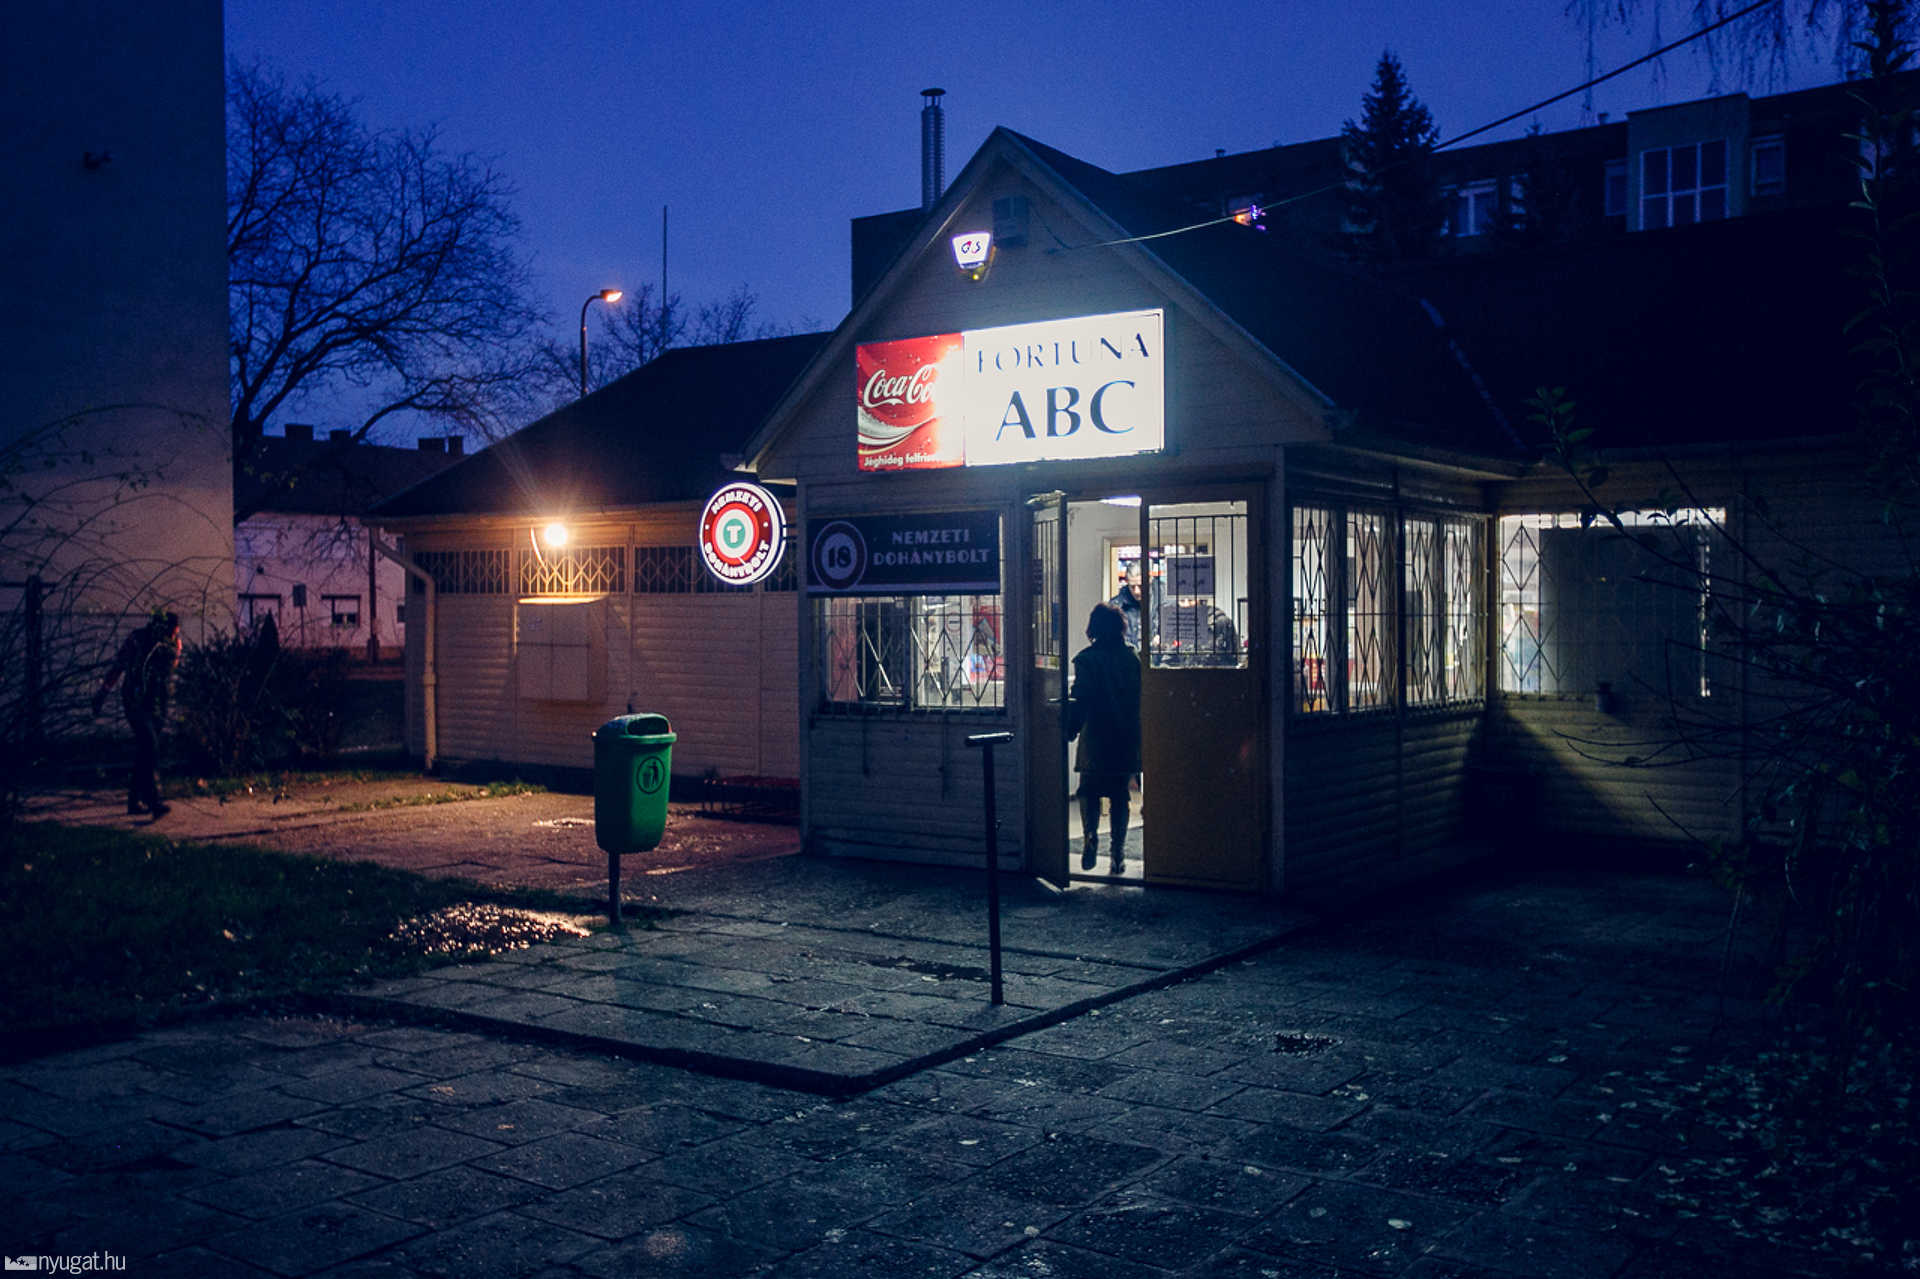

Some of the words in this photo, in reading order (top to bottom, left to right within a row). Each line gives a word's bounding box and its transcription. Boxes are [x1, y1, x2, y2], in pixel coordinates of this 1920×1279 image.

[863, 364, 939, 407] Coca-Co
[995, 380, 1136, 441] ABC
[711, 491, 763, 514] NEMZETI
[726, 525, 742, 544] T
[891, 528, 970, 545] NEMZETI
[828, 546, 851, 568] 18
[872, 547, 992, 567] DOHÁNYBOLT
